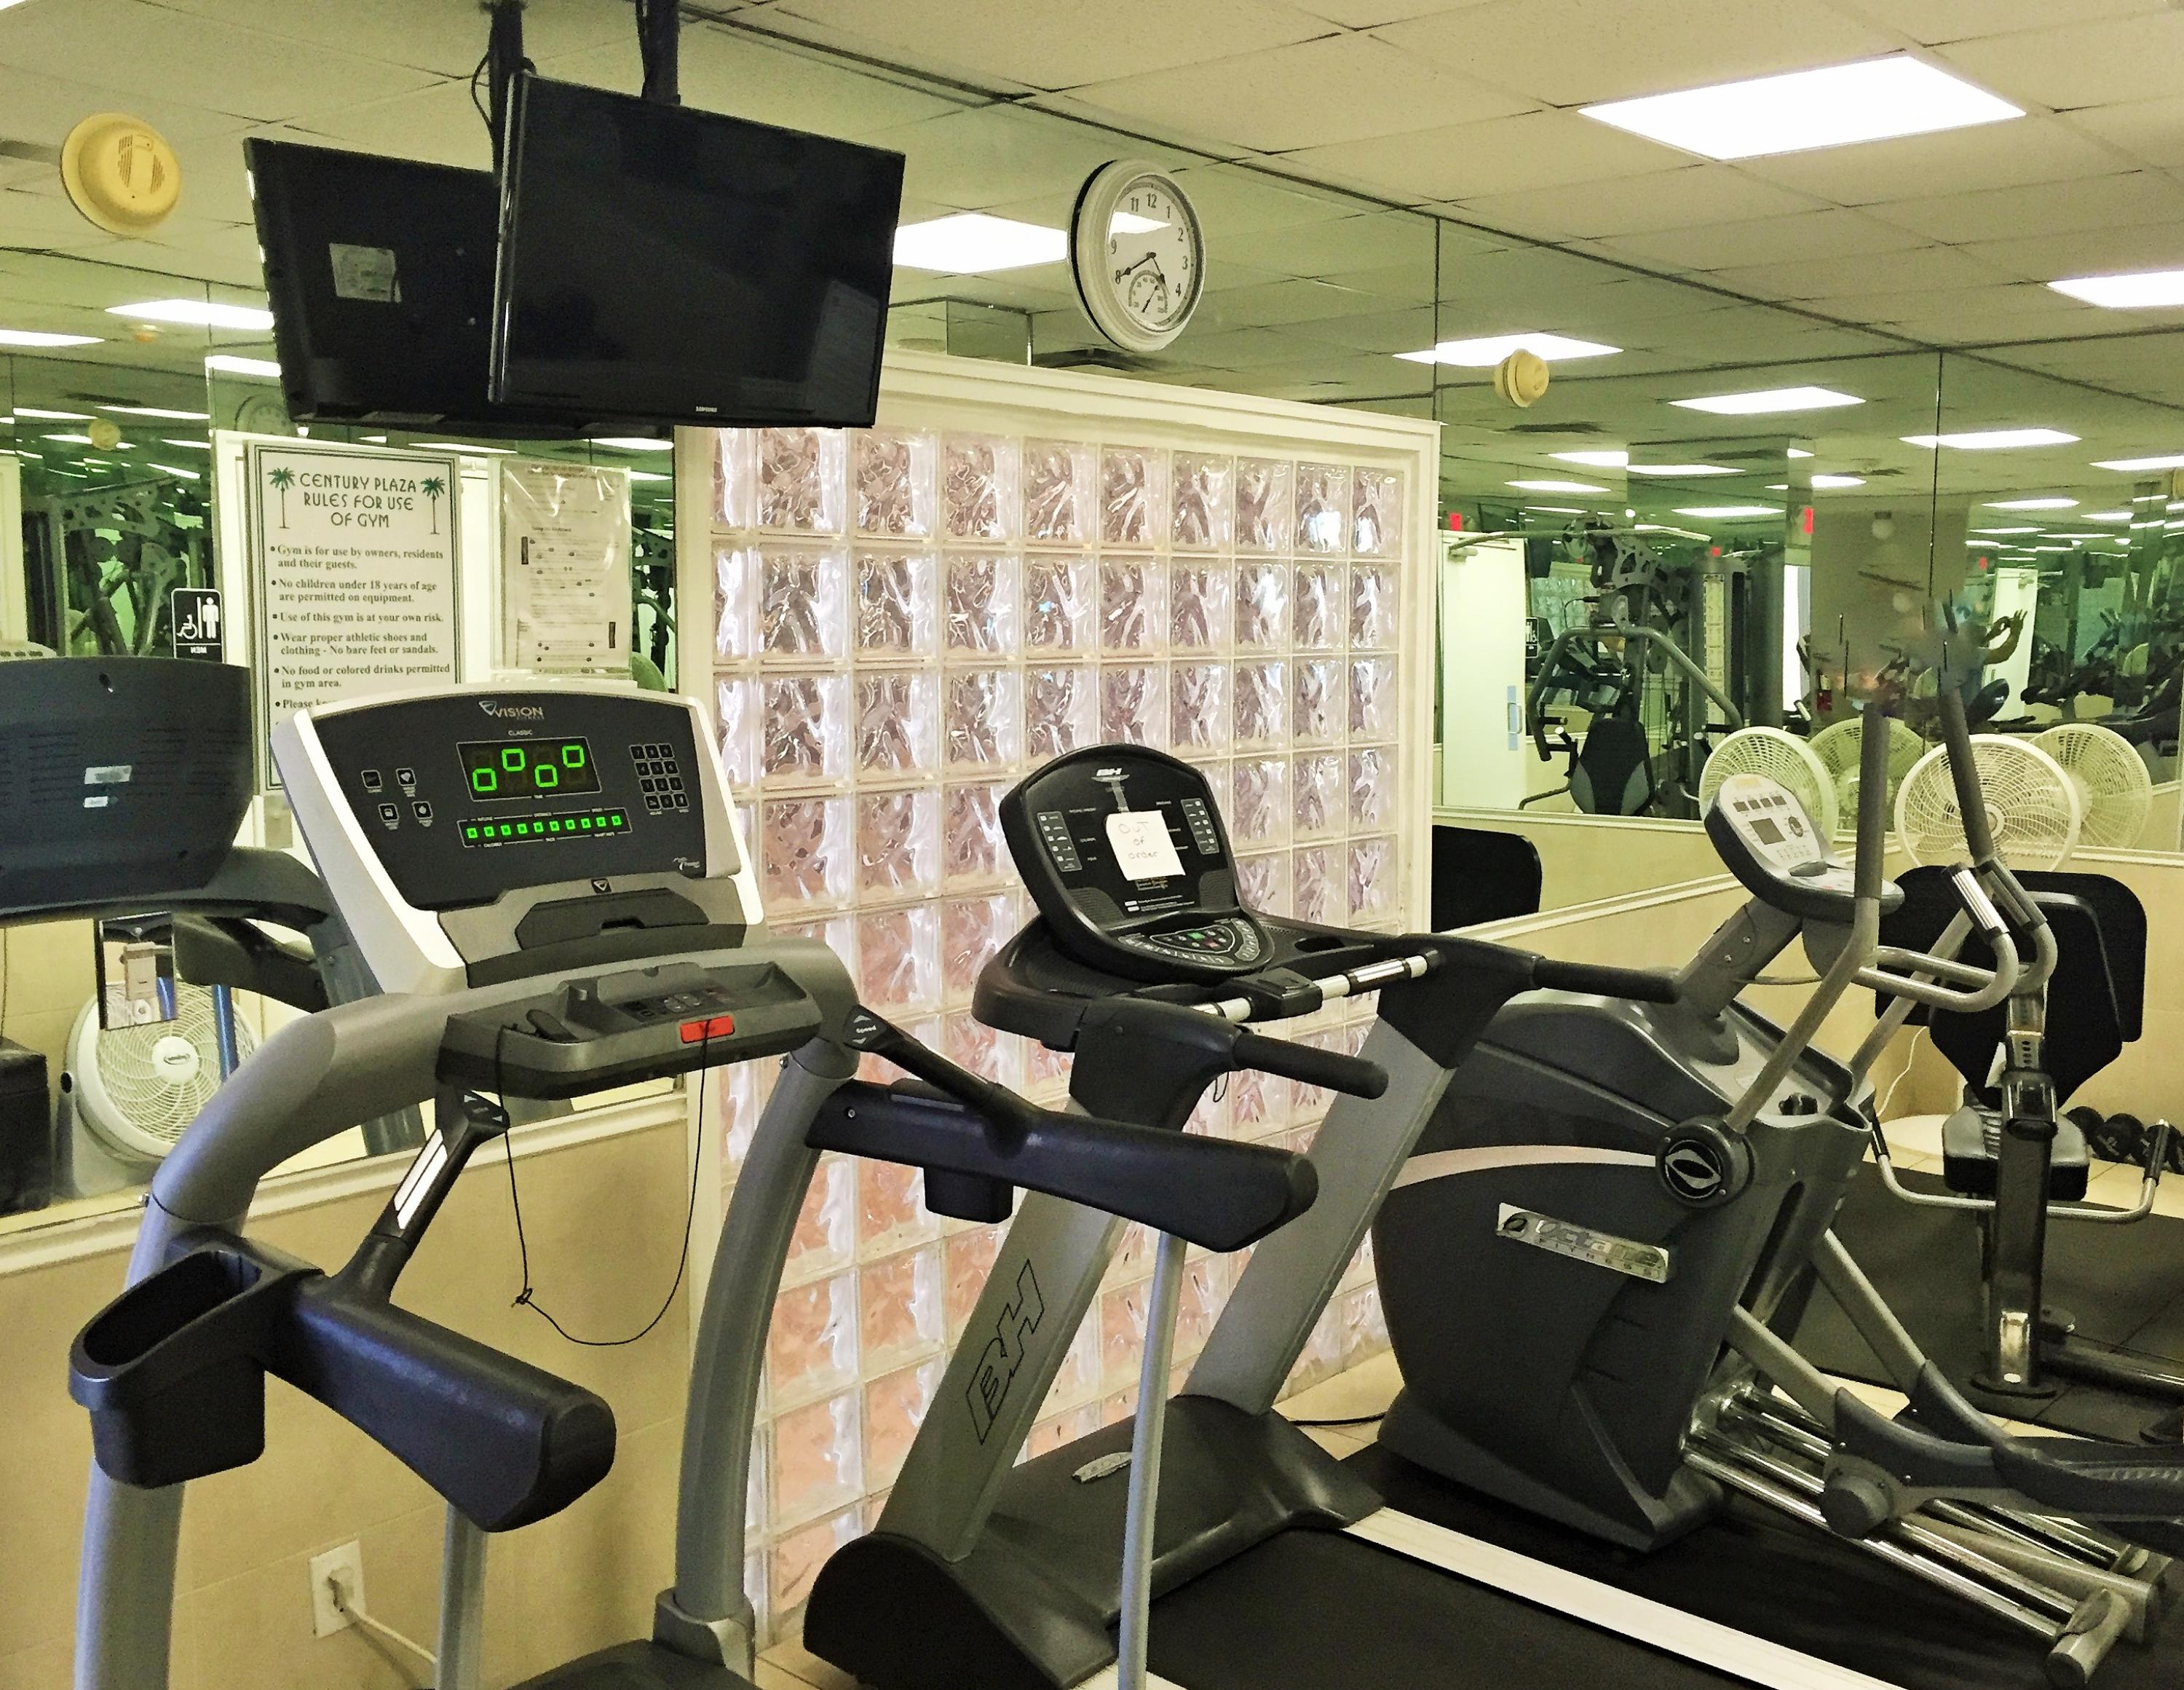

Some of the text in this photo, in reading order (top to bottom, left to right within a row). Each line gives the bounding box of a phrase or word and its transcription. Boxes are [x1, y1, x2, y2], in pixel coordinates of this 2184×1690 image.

[1131, 197, 1139, 212] 11
[1147, 192, 1157, 209] 12
[1166, 205, 1171, 219] 1
[1178, 227, 1184, 242] 2
[1111, 240, 1117, 255] 9
[1182, 256, 1188, 270] 3
[1115, 269, 1121, 285] 8
[1175, 283, 1181, 297] 4
[300, 473, 416, 492] CENTURY PLAZA
[304, 492, 414, 510] RULES FOR USE
[331, 512, 389, 528] OF GYM
[277, 545, 443, 559] Gym is for use by owners, residents
[278, 558, 357, 571] and their guests.
[280, 578, 437, 593] No children under 18 years of age
[298, 593, 345, 603] permitted
[363, 594, 414, 604] equipment.
[301, 612, 310, 620] of
[313, 613, 331, 621] this
[333, 615, 355, 624] gym
[379, 615, 400, 623] your
[424, 614, 443, 622] risk.
[281, 633, 427, 644] Wear proper athletic shoes and
[281, 646, 320, 656] clothing
[330, 646, 344, 655] No
[347, 646, 367, 654] bare
[370, 646, 386, 654] feet
[402, 645, 438, 654] sandals.
[282, 666, 296, 675] No
[298, 666, 319, 674] food
[336, 666, 370, 674] colored
[374, 666, 403, 674] drinks
[406, 664, 450, 674] permitted
[282, 679, 341, 690] in gym area.
[282, 698, 312, 708] Please
[495, 706, 544, 718] VISION
[1133, 837, 1145, 846] of
[1128, 850, 1158, 860] order
[966, 1258, 1045, 1445] BH
